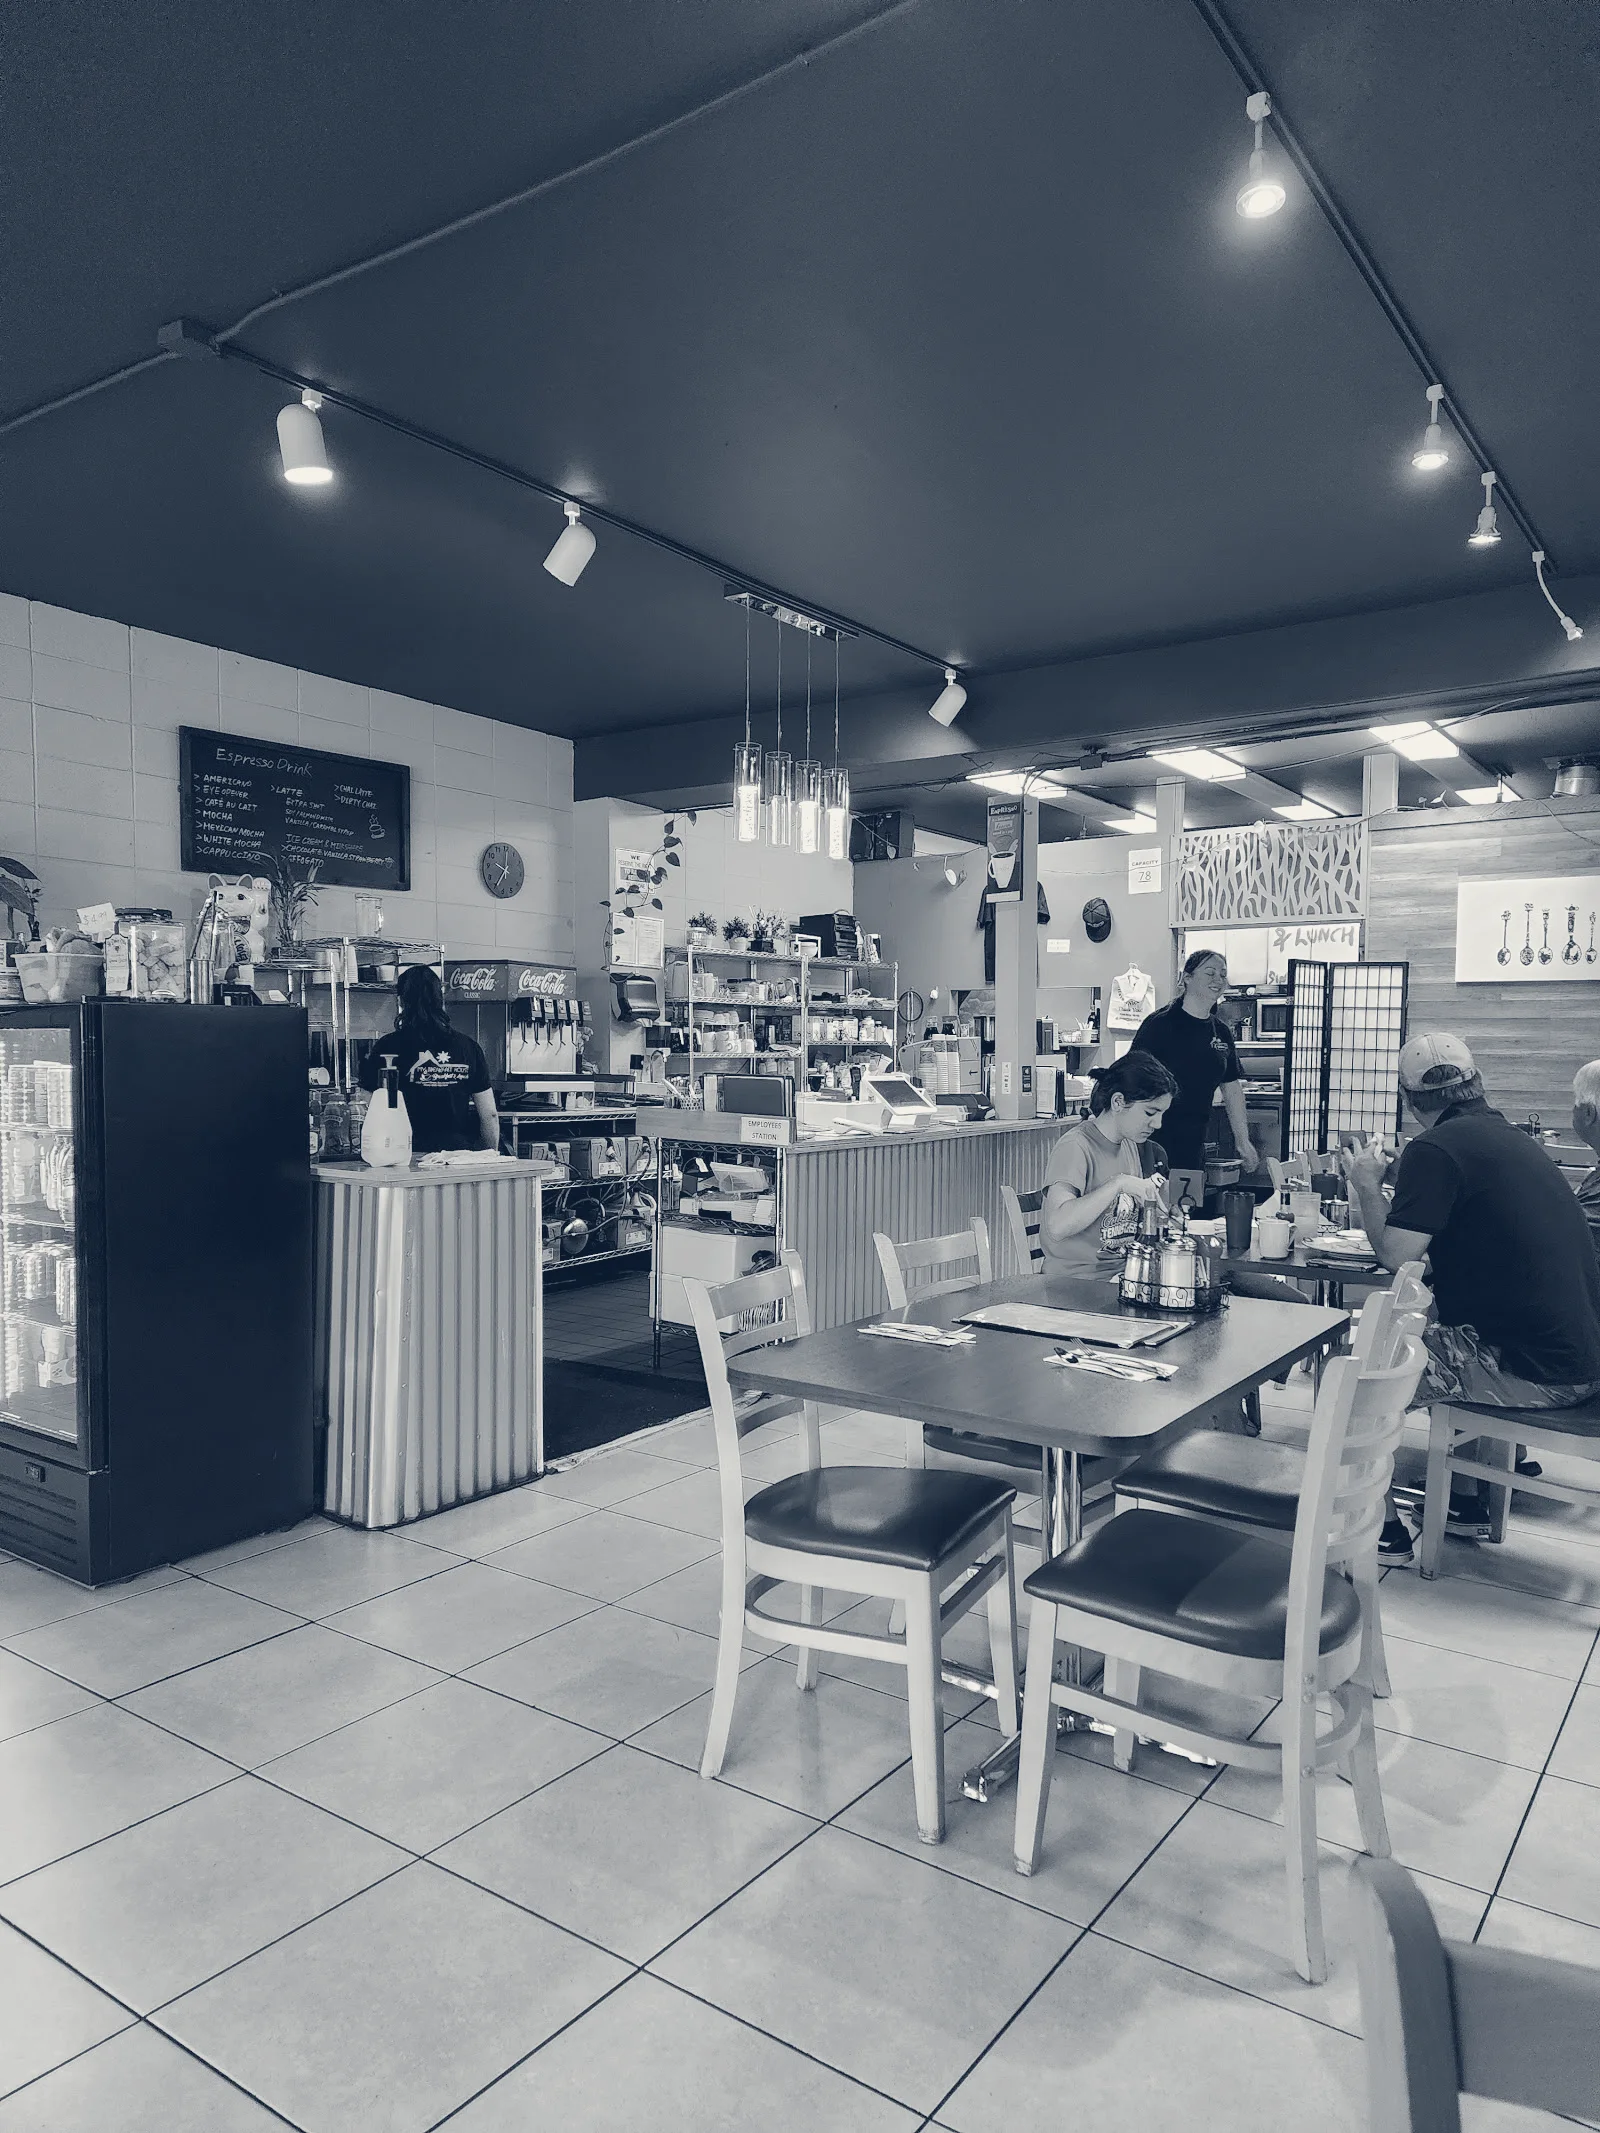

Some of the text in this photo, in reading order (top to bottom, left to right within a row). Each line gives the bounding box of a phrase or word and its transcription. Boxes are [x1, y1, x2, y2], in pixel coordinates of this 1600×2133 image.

[216, 748, 312, 777] Espresso Drink
[203, 774, 252, 787] AMERICANO
[203, 785, 220, 794] EYE
[276, 786, 303, 797] LATTE
[354, 786, 373, 798] LATTE
[341, 795, 361, 807] DIRTY
[238, 803, 257, 812] LAIT
[203, 810, 233, 821] MOCHA
[203, 823, 265, 838] MEXICAN MOCHA
[203, 834, 262, 850] WHITE MOCHA
[285, 833, 300, 843] ICE
[203, 847, 261, 860] CAPPUCCINO
[1131, 859, 1159, 867] CAPACITY
[1138, 871, 1152, 882] 78
[1295, 926, 1354, 947] LUNCH
[450, 968, 497, 991] Coca-Cola
[519, 969, 567, 996] Coca-Cola
[748, 1121, 782, 1129] EMPLOYEES
[1179, 1177, 1191, 1196] 7
